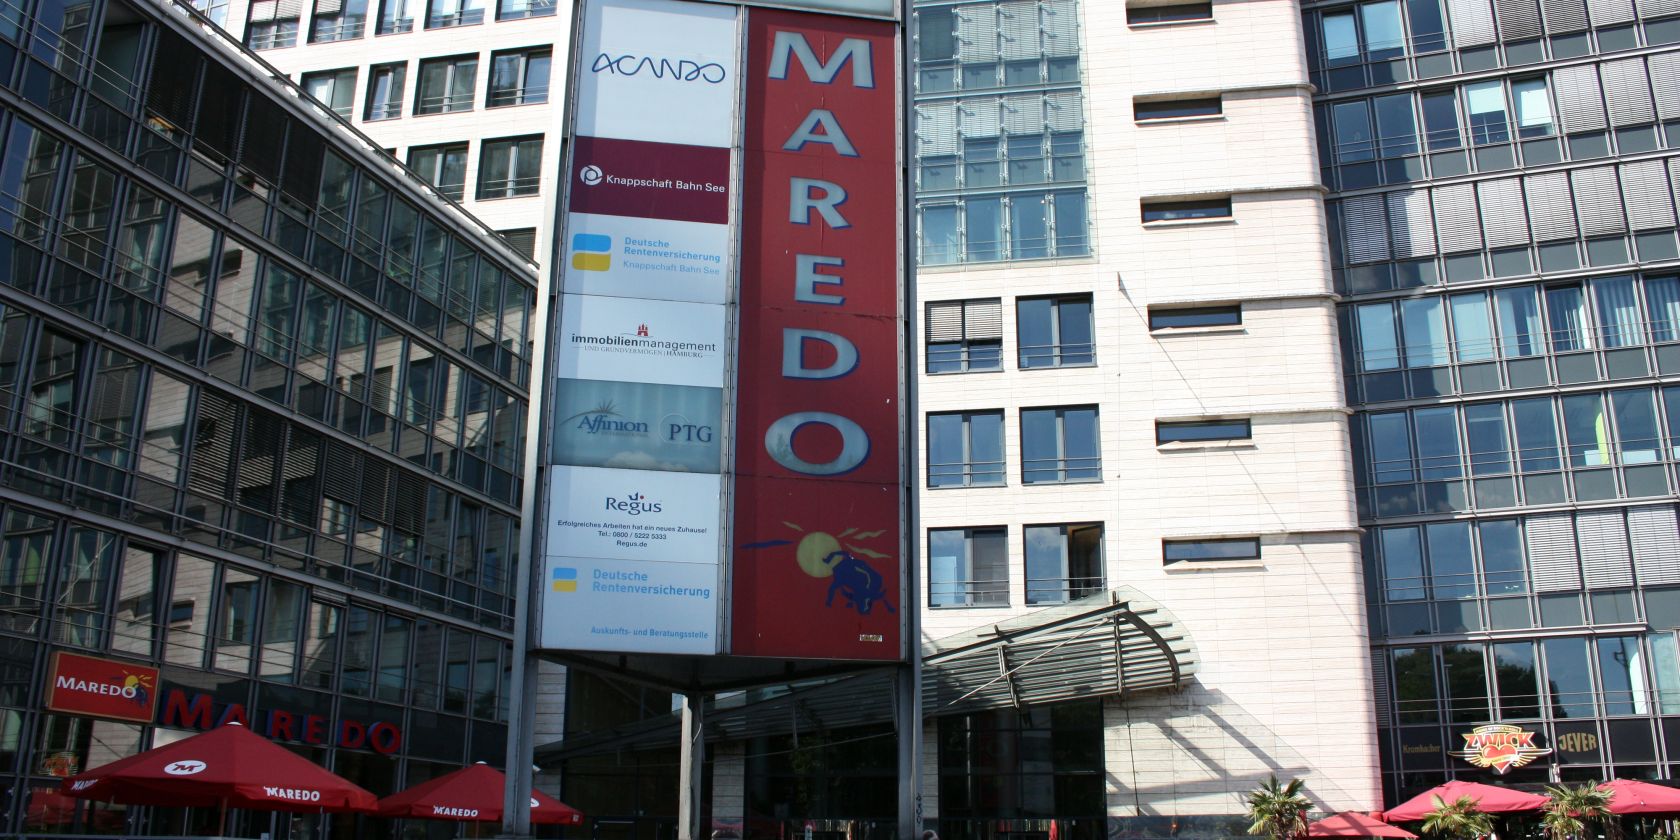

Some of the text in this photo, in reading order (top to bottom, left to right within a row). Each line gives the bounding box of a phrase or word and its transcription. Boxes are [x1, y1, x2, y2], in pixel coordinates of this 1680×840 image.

[606, 174, 726, 193] Knappschaft Bahn See
[624, 236, 670, 248] Deutsche
[623, 246, 721, 264] Rentenversicherung
[623, 259, 720, 275] Knappschaft Bahn See
[571, 333, 716, 352] immobilienmanagement
[577, 414, 649, 434] Affinion
[668, 423, 713, 443] PTG
[605, 492, 662, 516] Regus
[557, 520, 602, 529] Erfolgreiches
[603, 522, 631, 530] Arbeiten
[677, 526, 708, 534] Zuhause!
[612, 531, 629, 539] 0800
[634, 532, 650, 540] 5222
[651, 533, 667, 541] 5333
[616, 540, 648, 549] Regus.de
[593, 569, 649, 582] Deutsche
[592, 581, 711, 600] Rentenversicherung
[591, 626, 709, 641] Auskunfts- und Beratungsstelle
[56, 675, 137, 700] MAREDO
[1462, 732, 1537, 750] ZWICK
[1558, 733, 1597, 753] JEVER
[263, 786, 321, 802] MAREDO
[433, 804, 479, 818] MAREDO
